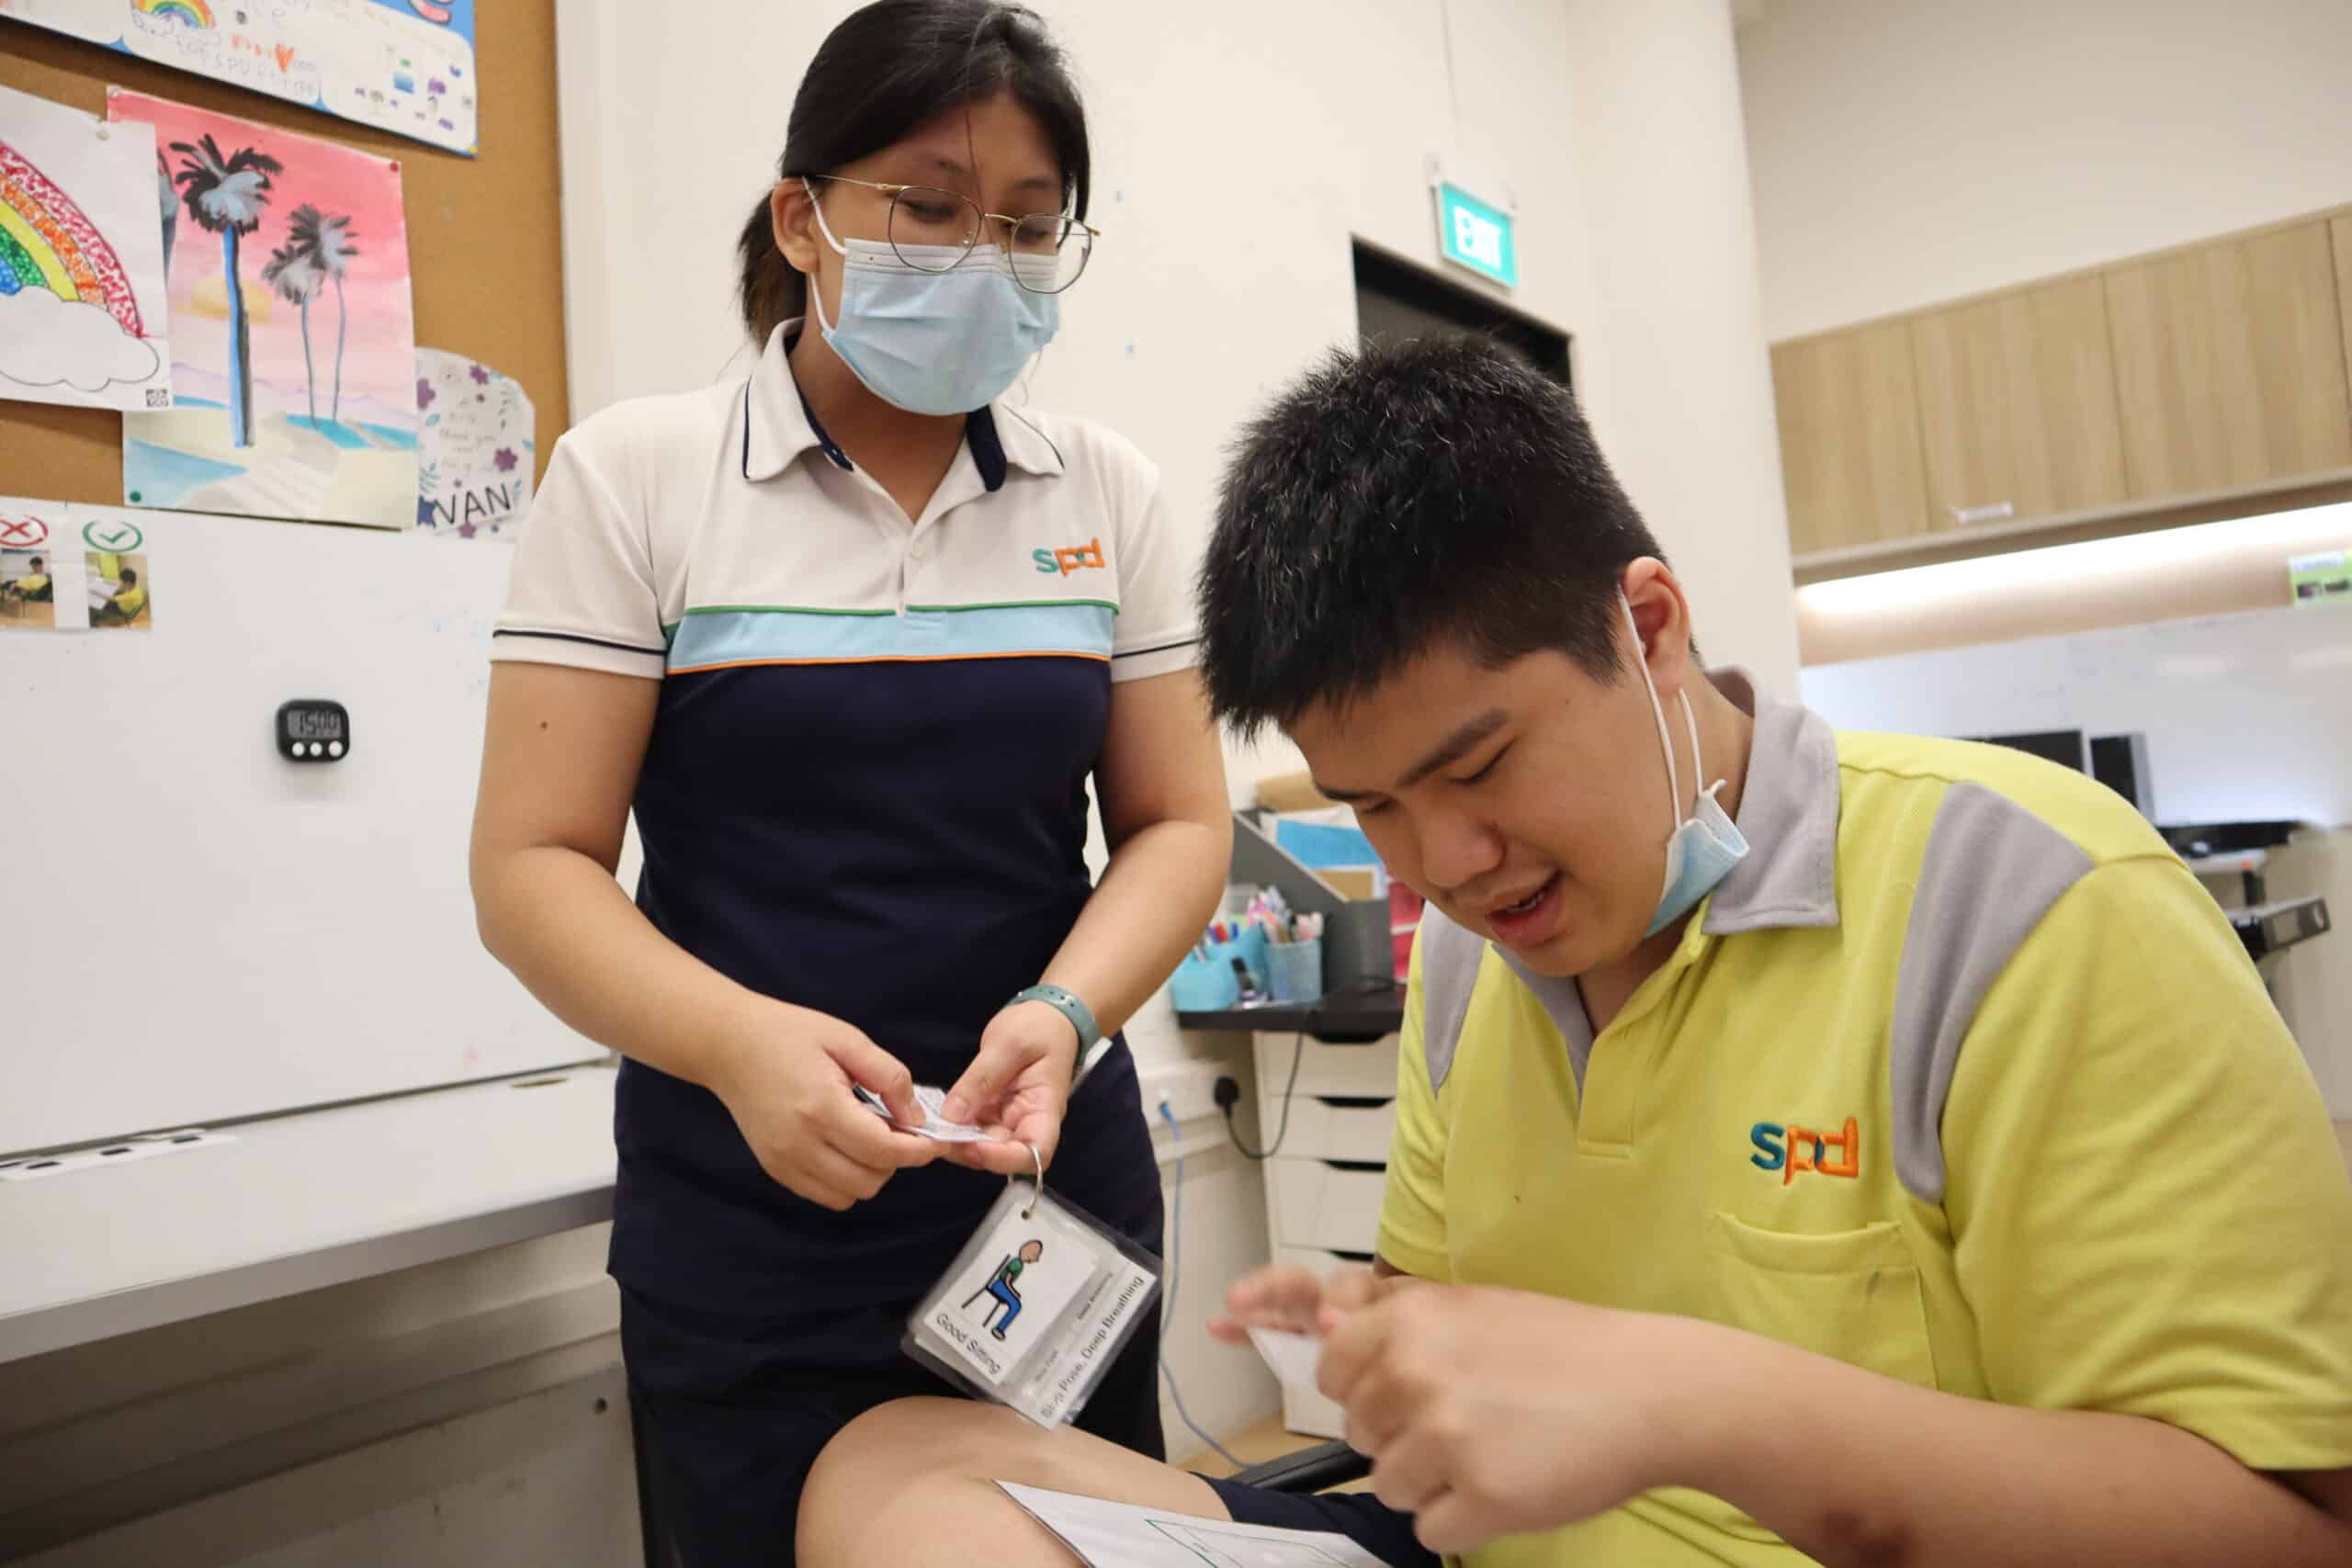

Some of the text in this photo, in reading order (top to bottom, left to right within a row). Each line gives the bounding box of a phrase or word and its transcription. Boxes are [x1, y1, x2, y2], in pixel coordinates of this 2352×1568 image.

[1032, 536, 1105, 578] spd
[1750, 1116, 1860, 1186] spd
[936, 1314, 968, 1344] Good
[1080, 1328, 1108, 1359] Deep
[1102, 1275, 1146, 1329] Breathing
